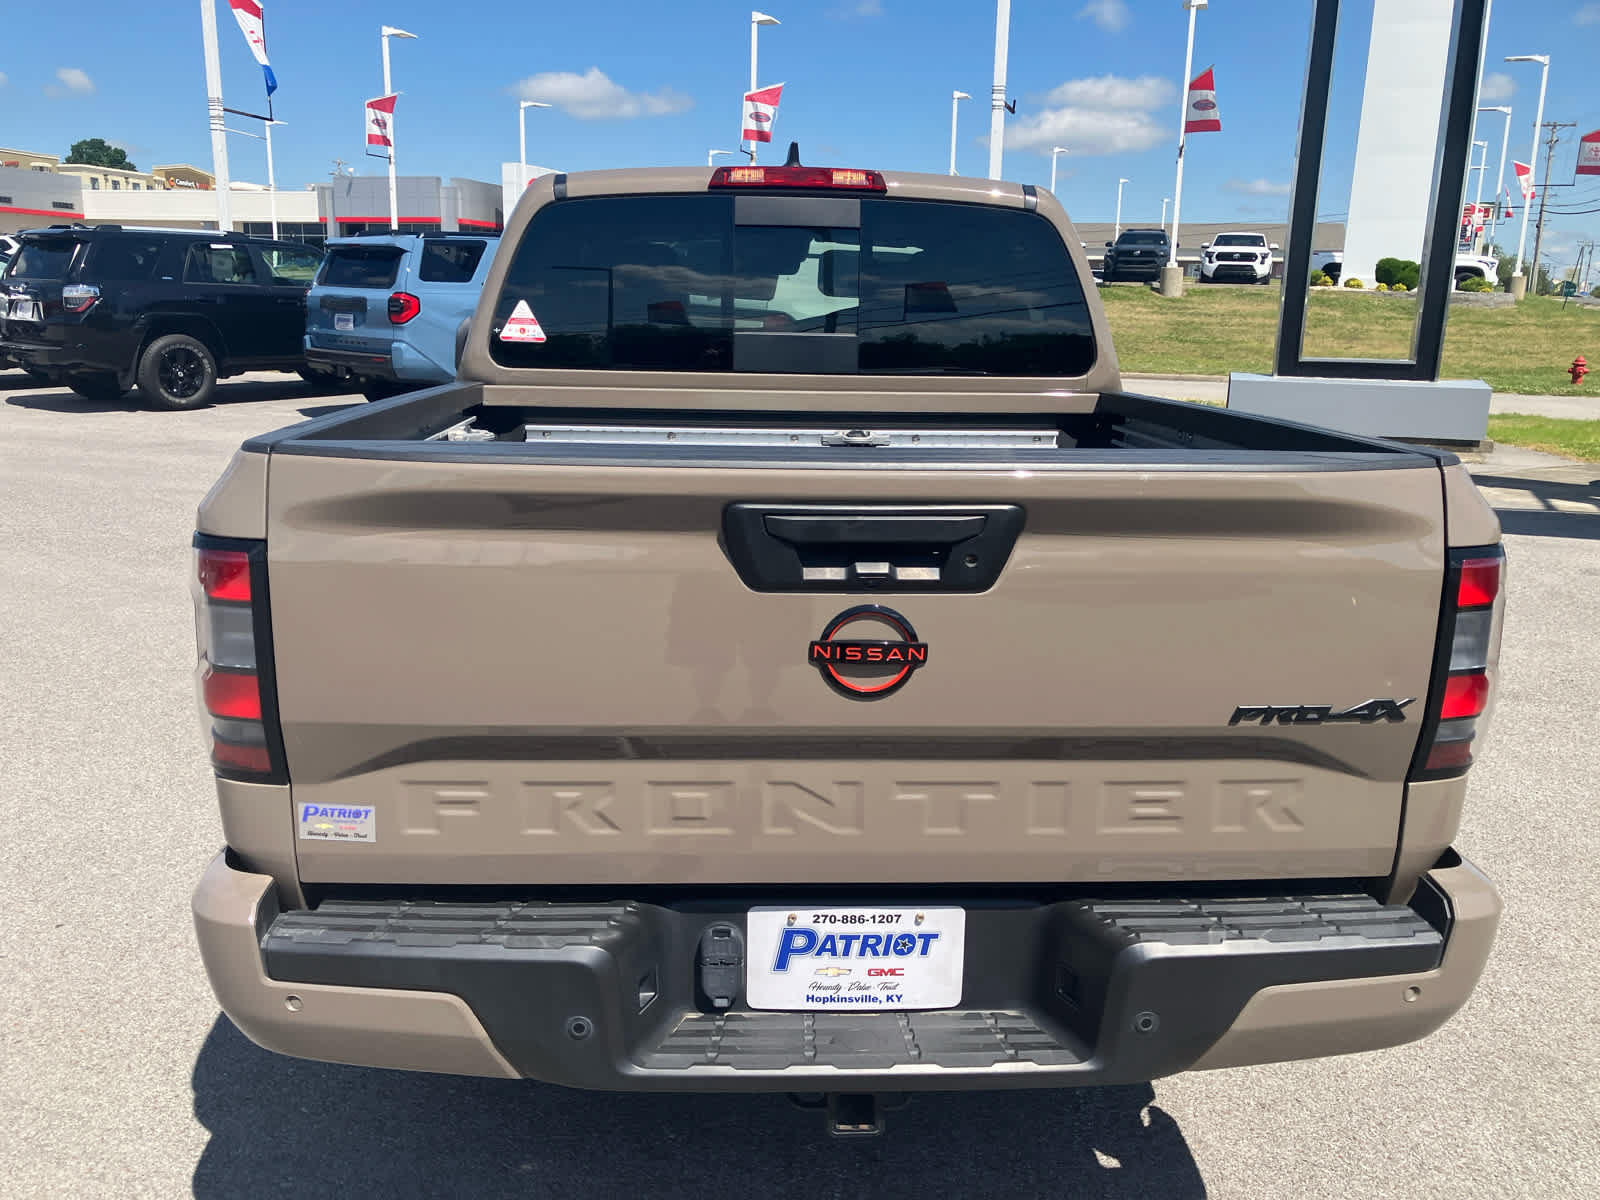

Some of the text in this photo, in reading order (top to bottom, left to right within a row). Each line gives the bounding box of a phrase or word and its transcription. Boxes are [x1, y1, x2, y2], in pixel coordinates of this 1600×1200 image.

[813, 645, 925, 661] NISSAN
[1228, 697, 1416, 727] PRO-4X
[302, 804, 372, 822] PATRIOT
[400, 778, 1304, 836] FRONTIER
[812, 913, 902, 925] 270-886-1207
[773, 926, 940, 973] PATRIOT
[867, 968, 905, 977] GMC
[806, 994, 903, 1005] Hopkinsville, KY
